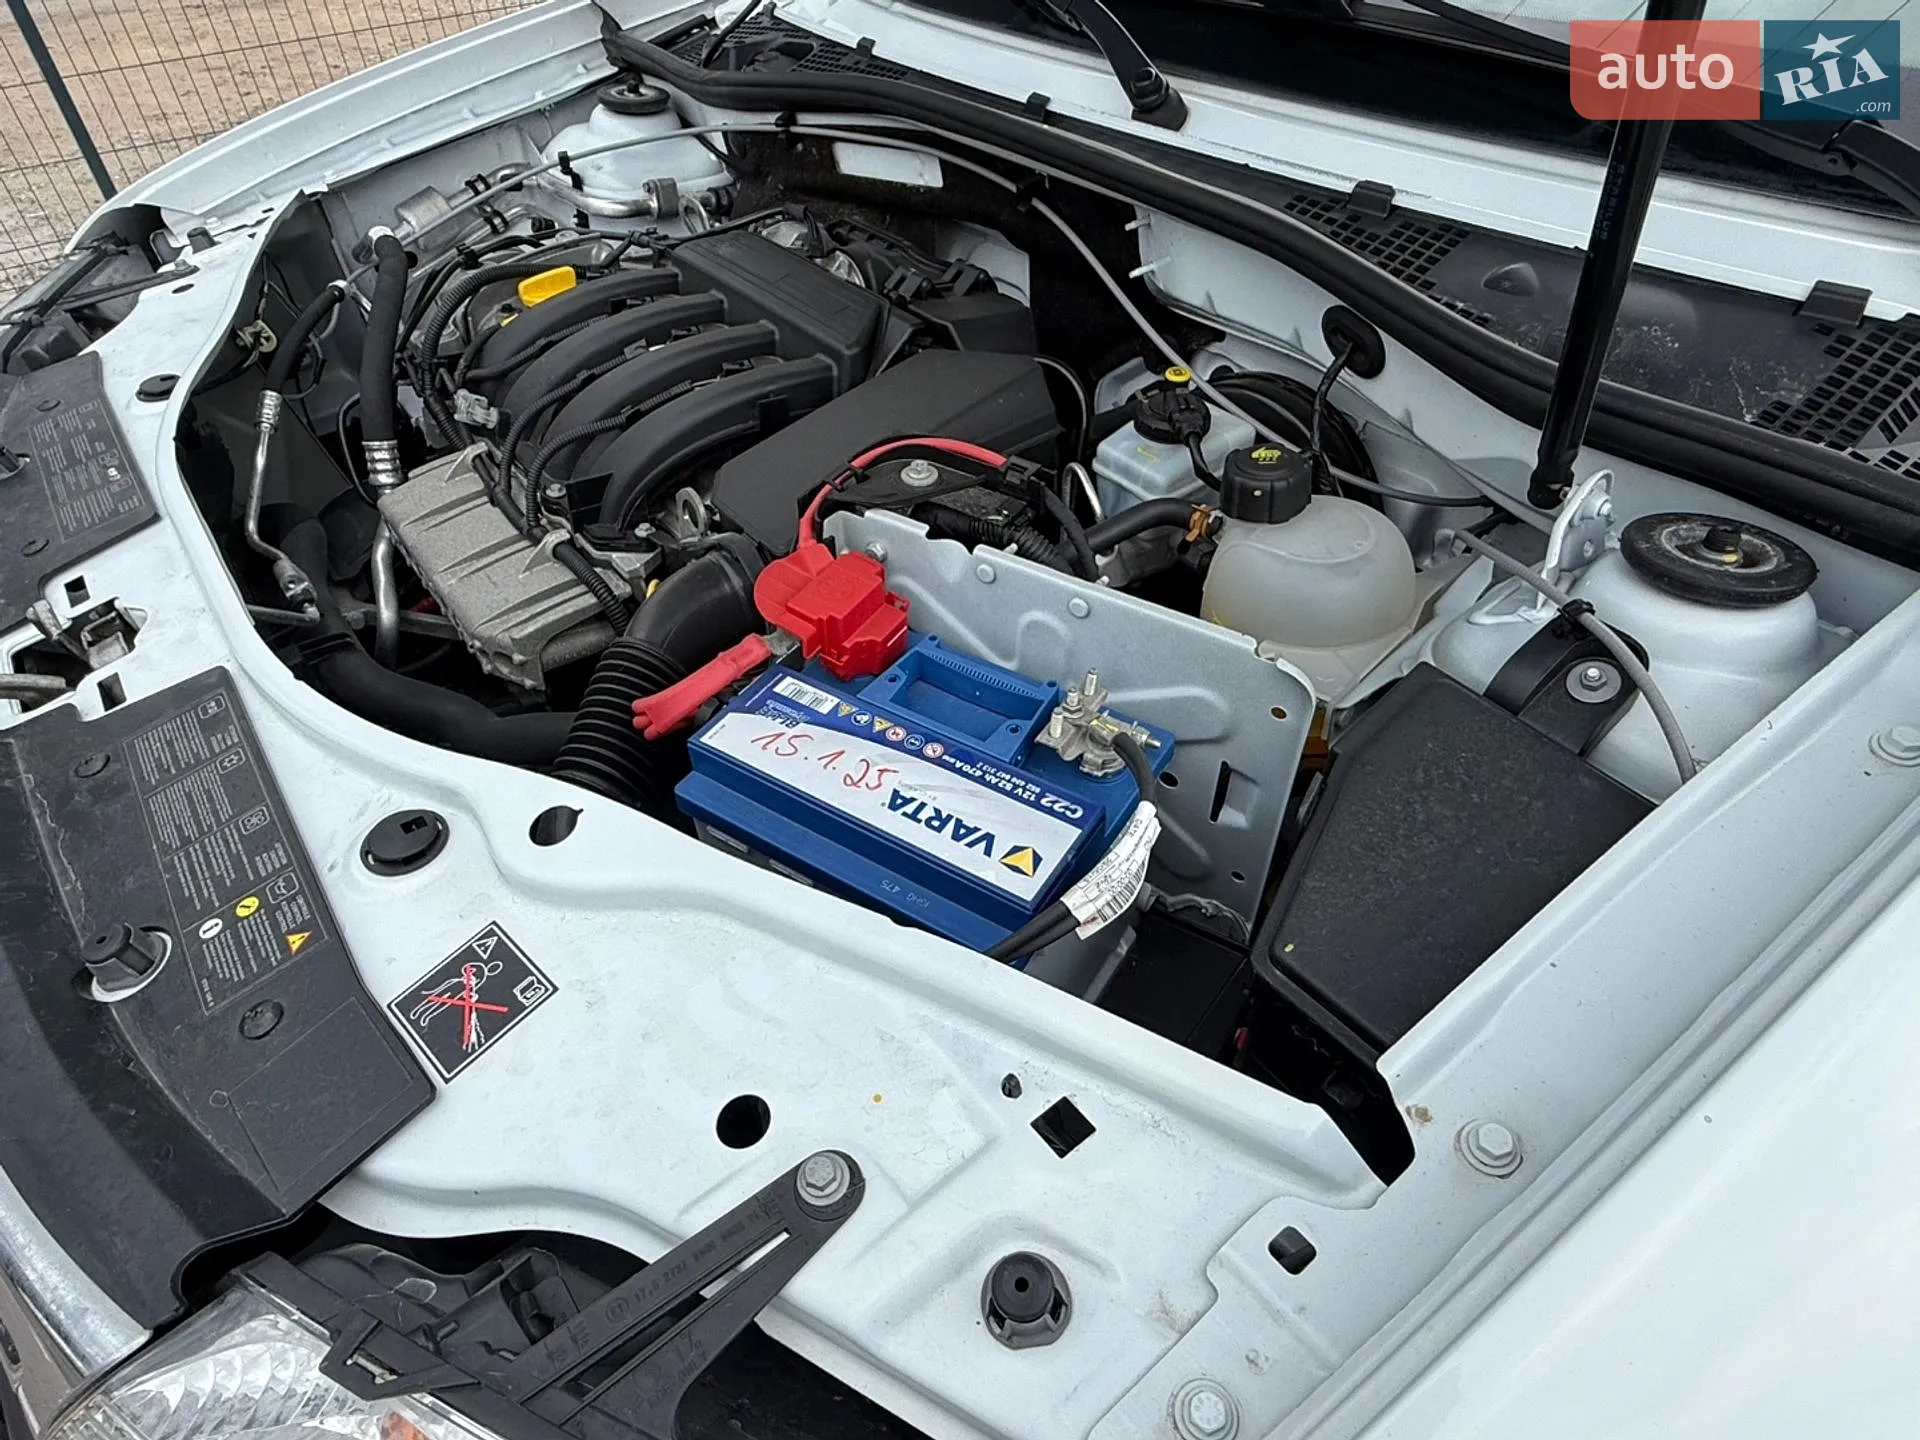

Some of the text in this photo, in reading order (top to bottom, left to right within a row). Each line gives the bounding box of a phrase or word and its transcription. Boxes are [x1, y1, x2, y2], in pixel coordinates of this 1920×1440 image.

[984, 773, 1013, 791] 52Ah
[1013, 787, 1036, 801] 12V
[1040, 792, 1084, 819] C22
[888, 788, 995, 858] VARTA
